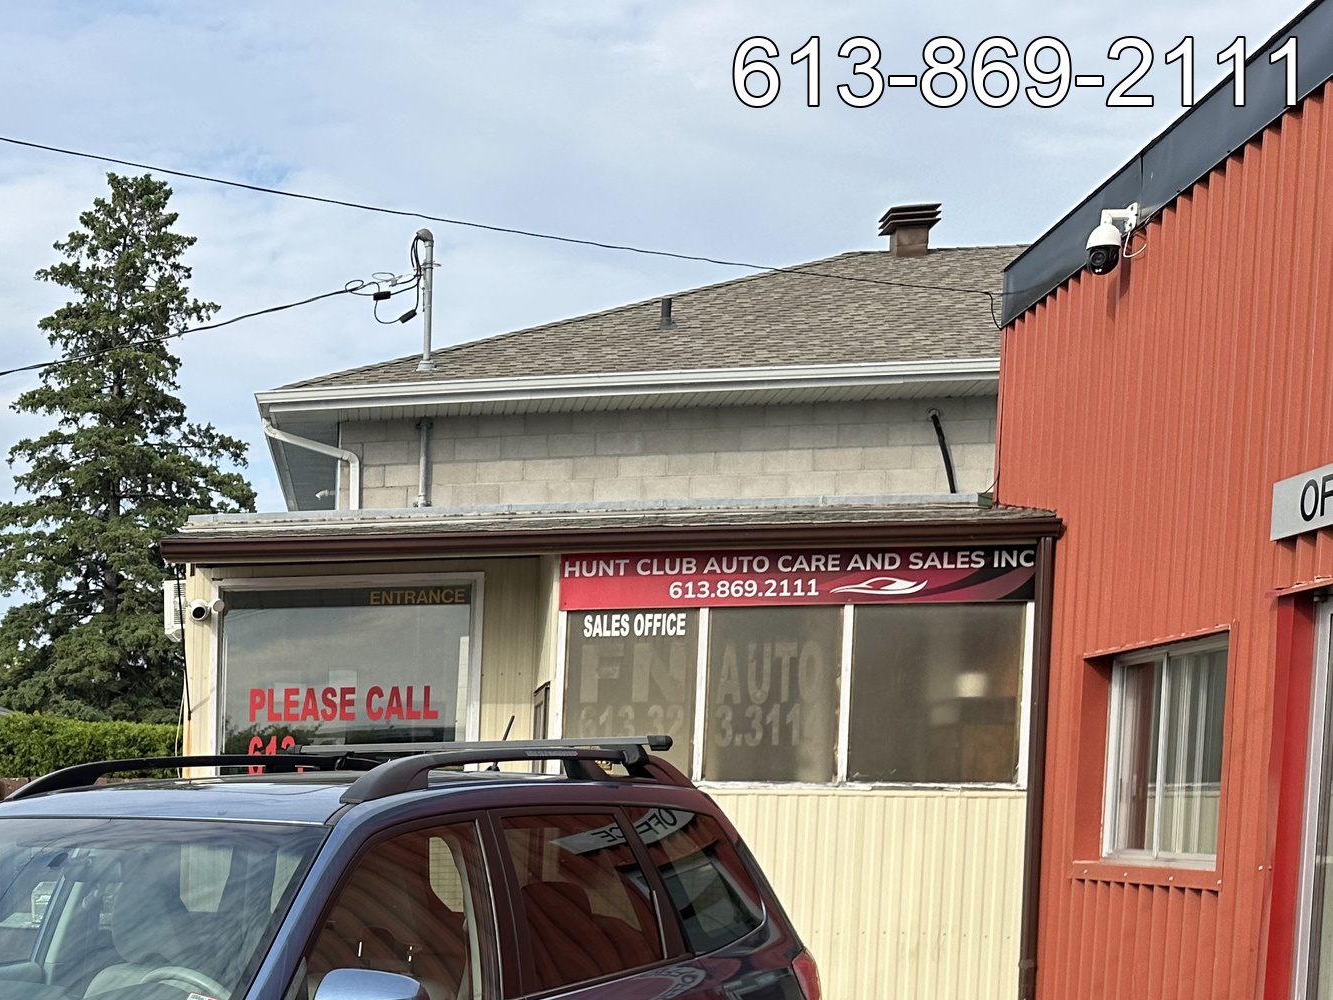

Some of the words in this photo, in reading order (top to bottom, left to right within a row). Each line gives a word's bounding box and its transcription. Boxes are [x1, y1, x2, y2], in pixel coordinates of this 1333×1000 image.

[564, 559, 630, 578] HUNT
[636, 557, 698, 576] CLUB
[703, 555, 770, 574] AUTO
[777, 554, 841, 573] CARE
[846, 552, 901, 571] AND
[908, 551, 986, 570] SALES
[993, 549, 1035, 568] INC
[370, 588, 466, 605] ENTRANCE
[668, 578, 819, 599] 613.869.2111
[583, 613, 630, 638] SALES
[633, 612, 687, 637] OFFICE
[248, 686, 356, 723] PLEASE
[366, 685, 439, 721] CALL
